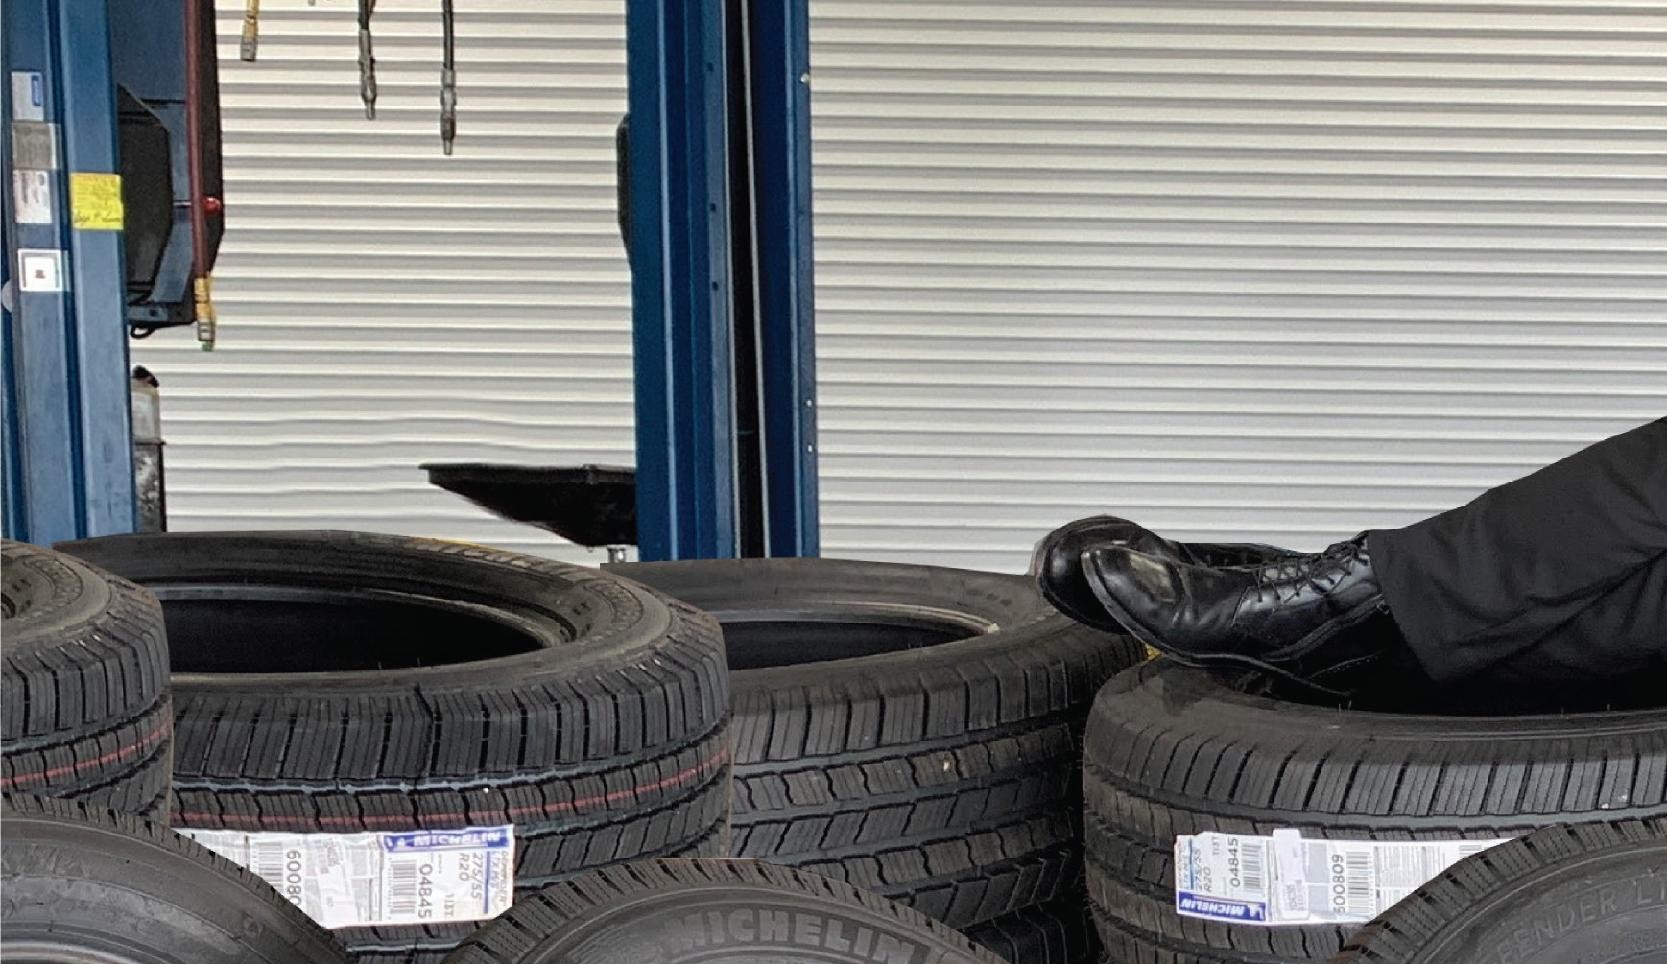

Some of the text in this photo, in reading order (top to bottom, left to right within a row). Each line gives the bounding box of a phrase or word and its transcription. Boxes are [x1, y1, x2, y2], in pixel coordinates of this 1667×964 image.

[413, 831, 500, 847] MICHELIN
[1228, 837, 1241, 888] 04845
[418, 863, 433, 919] 04845
[459, 852, 471, 882] R20
[471, 852, 484, 900] 275/55
[1202, 866, 1212, 892] R20
[1330, 853, 1346, 914] 600809
[1180, 898, 1245, 916] MICHELIN
[661, 908, 919, 964] MICHELIN
